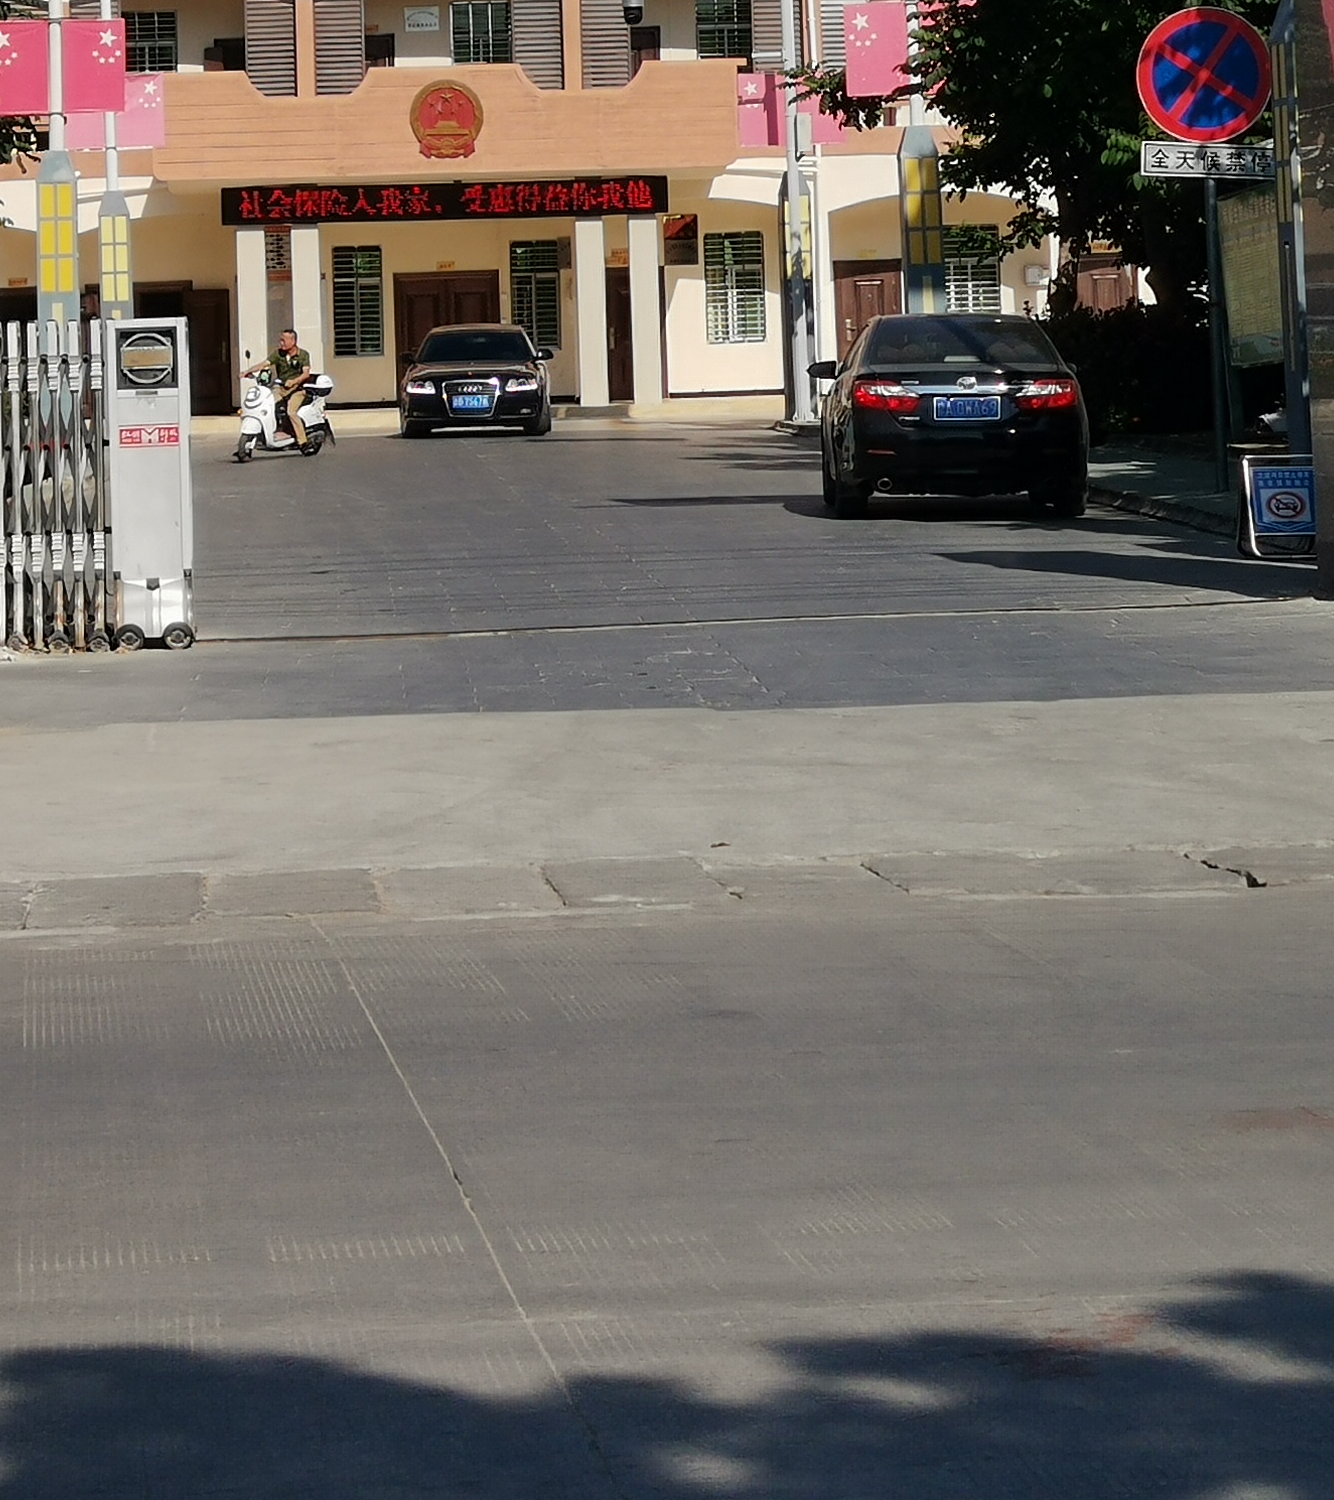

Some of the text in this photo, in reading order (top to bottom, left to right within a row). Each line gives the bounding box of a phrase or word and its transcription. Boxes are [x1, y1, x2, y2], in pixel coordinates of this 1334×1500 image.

[1150, 147, 1271, 173] 全天候禁停
